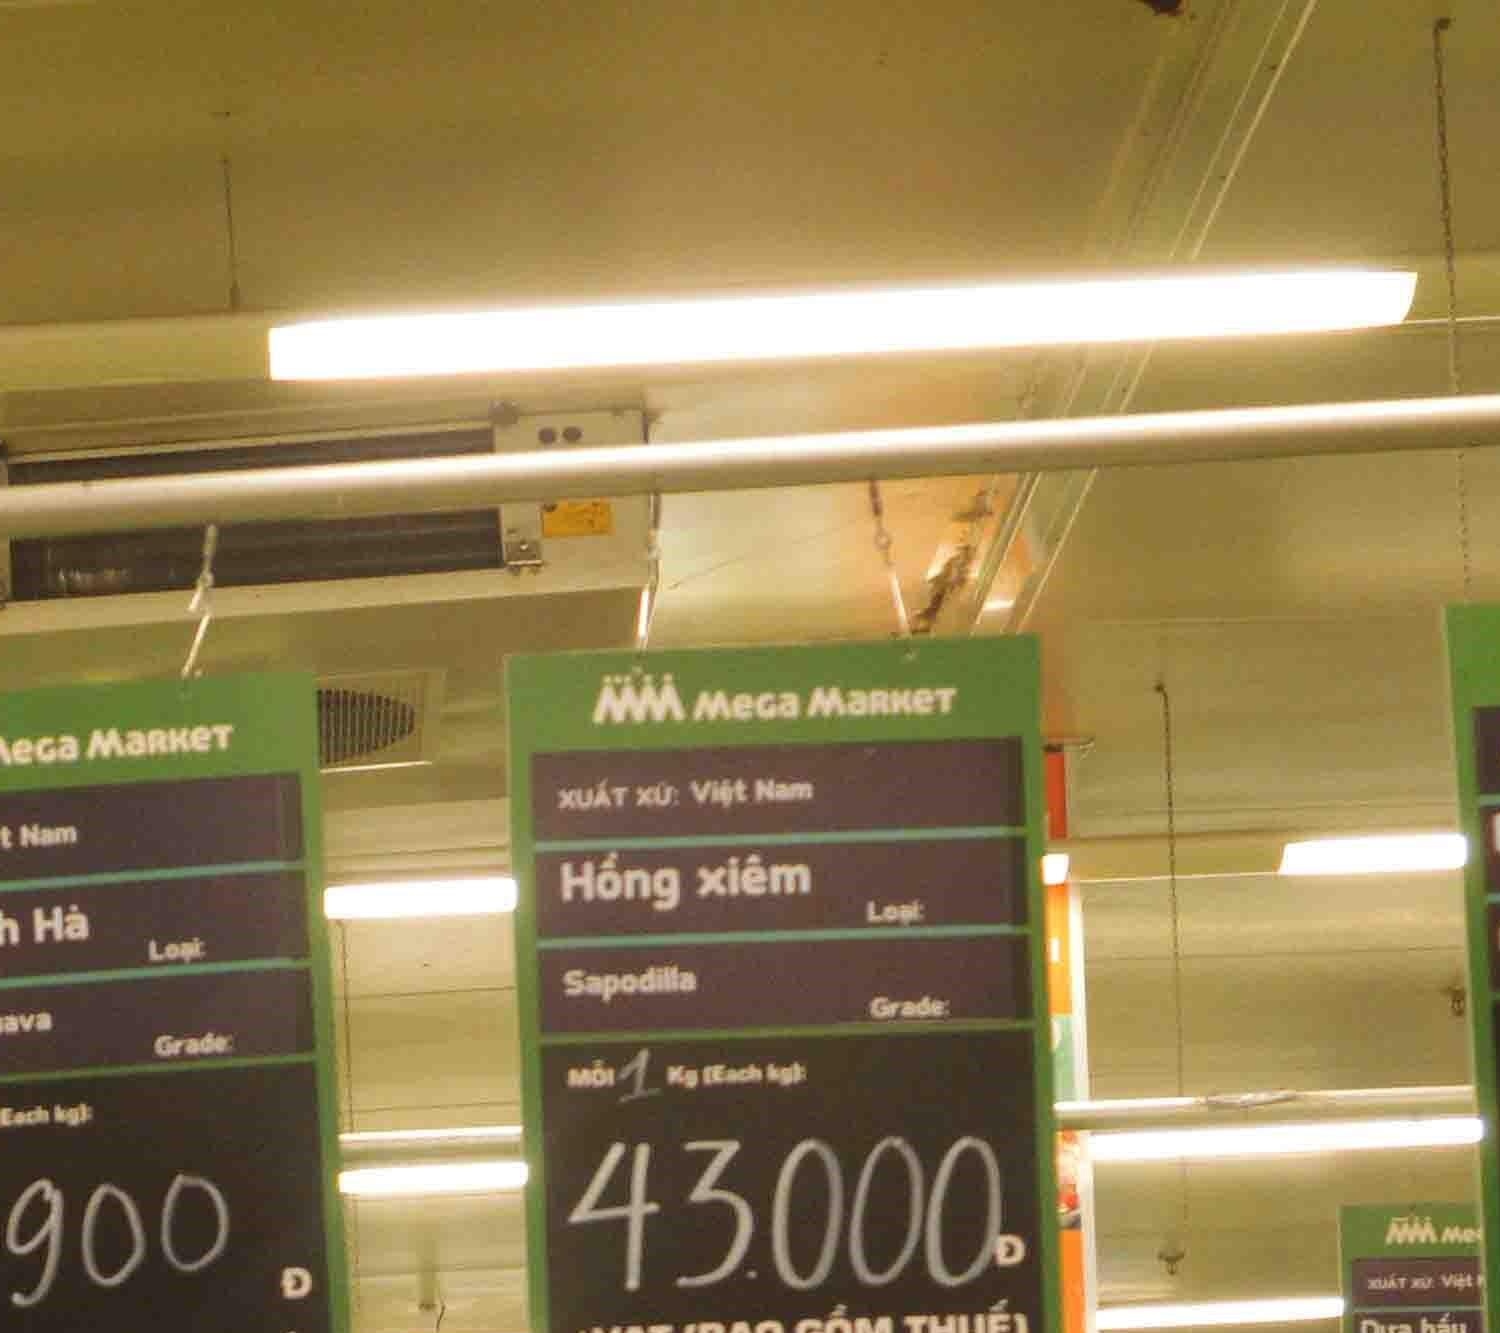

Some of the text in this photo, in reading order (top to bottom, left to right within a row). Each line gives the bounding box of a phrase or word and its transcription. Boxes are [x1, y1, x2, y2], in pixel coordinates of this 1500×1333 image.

[698, 856, 812, 897] xiêm
[32, 903, 89, 945] Hà
[563, 968, 696, 998] Sapodilla
[567, 1134, 1001, 1292] 43.000
